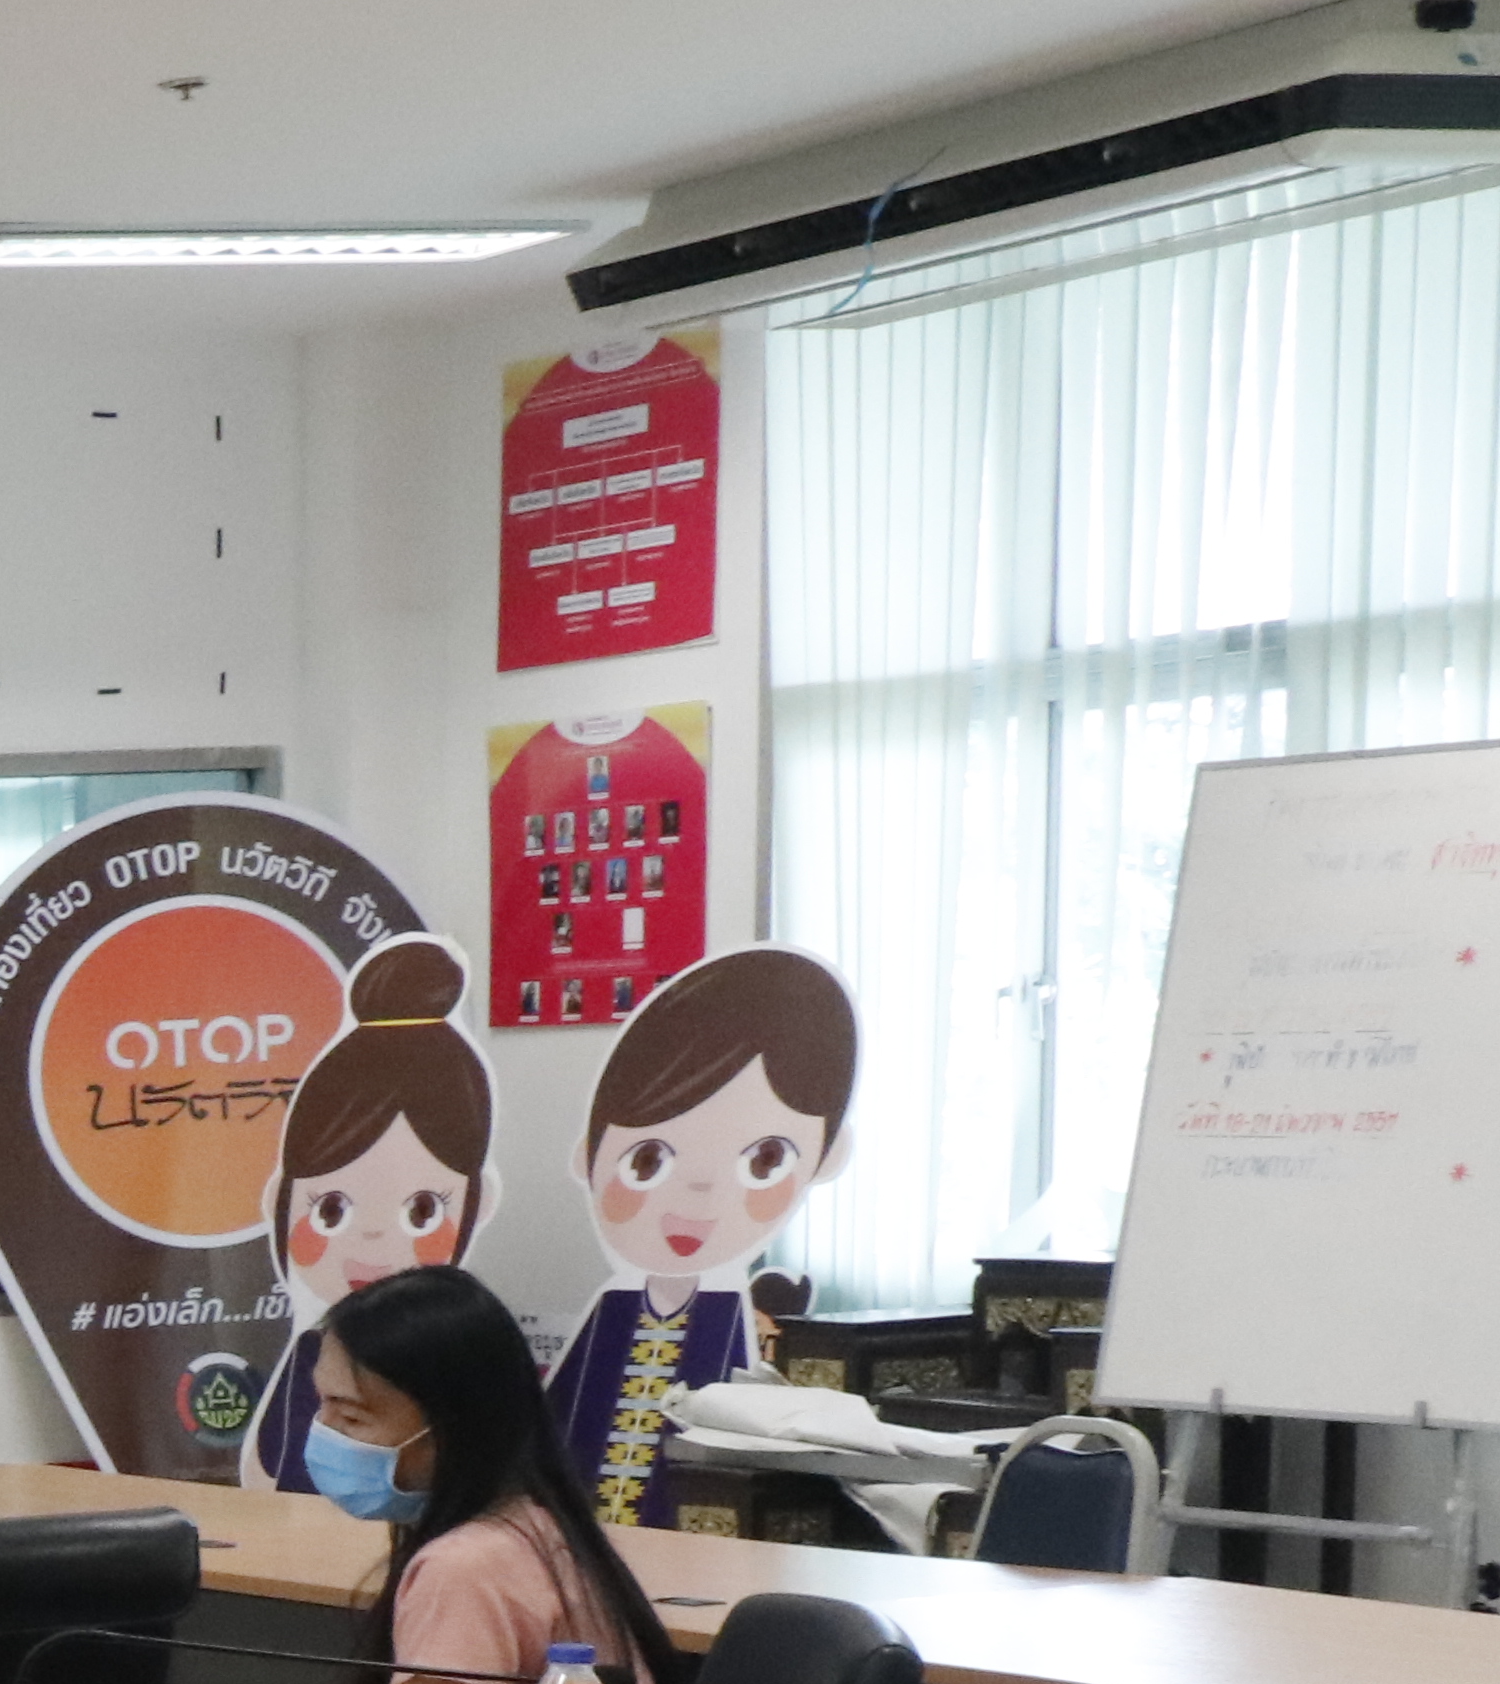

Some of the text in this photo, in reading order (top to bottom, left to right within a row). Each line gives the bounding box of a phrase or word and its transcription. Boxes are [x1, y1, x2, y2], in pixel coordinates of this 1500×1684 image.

[105, 840, 202, 889] OTOP
[221, 842, 338, 901] นวัตวิถี
[106, 1014, 294, 1069] OTOP
